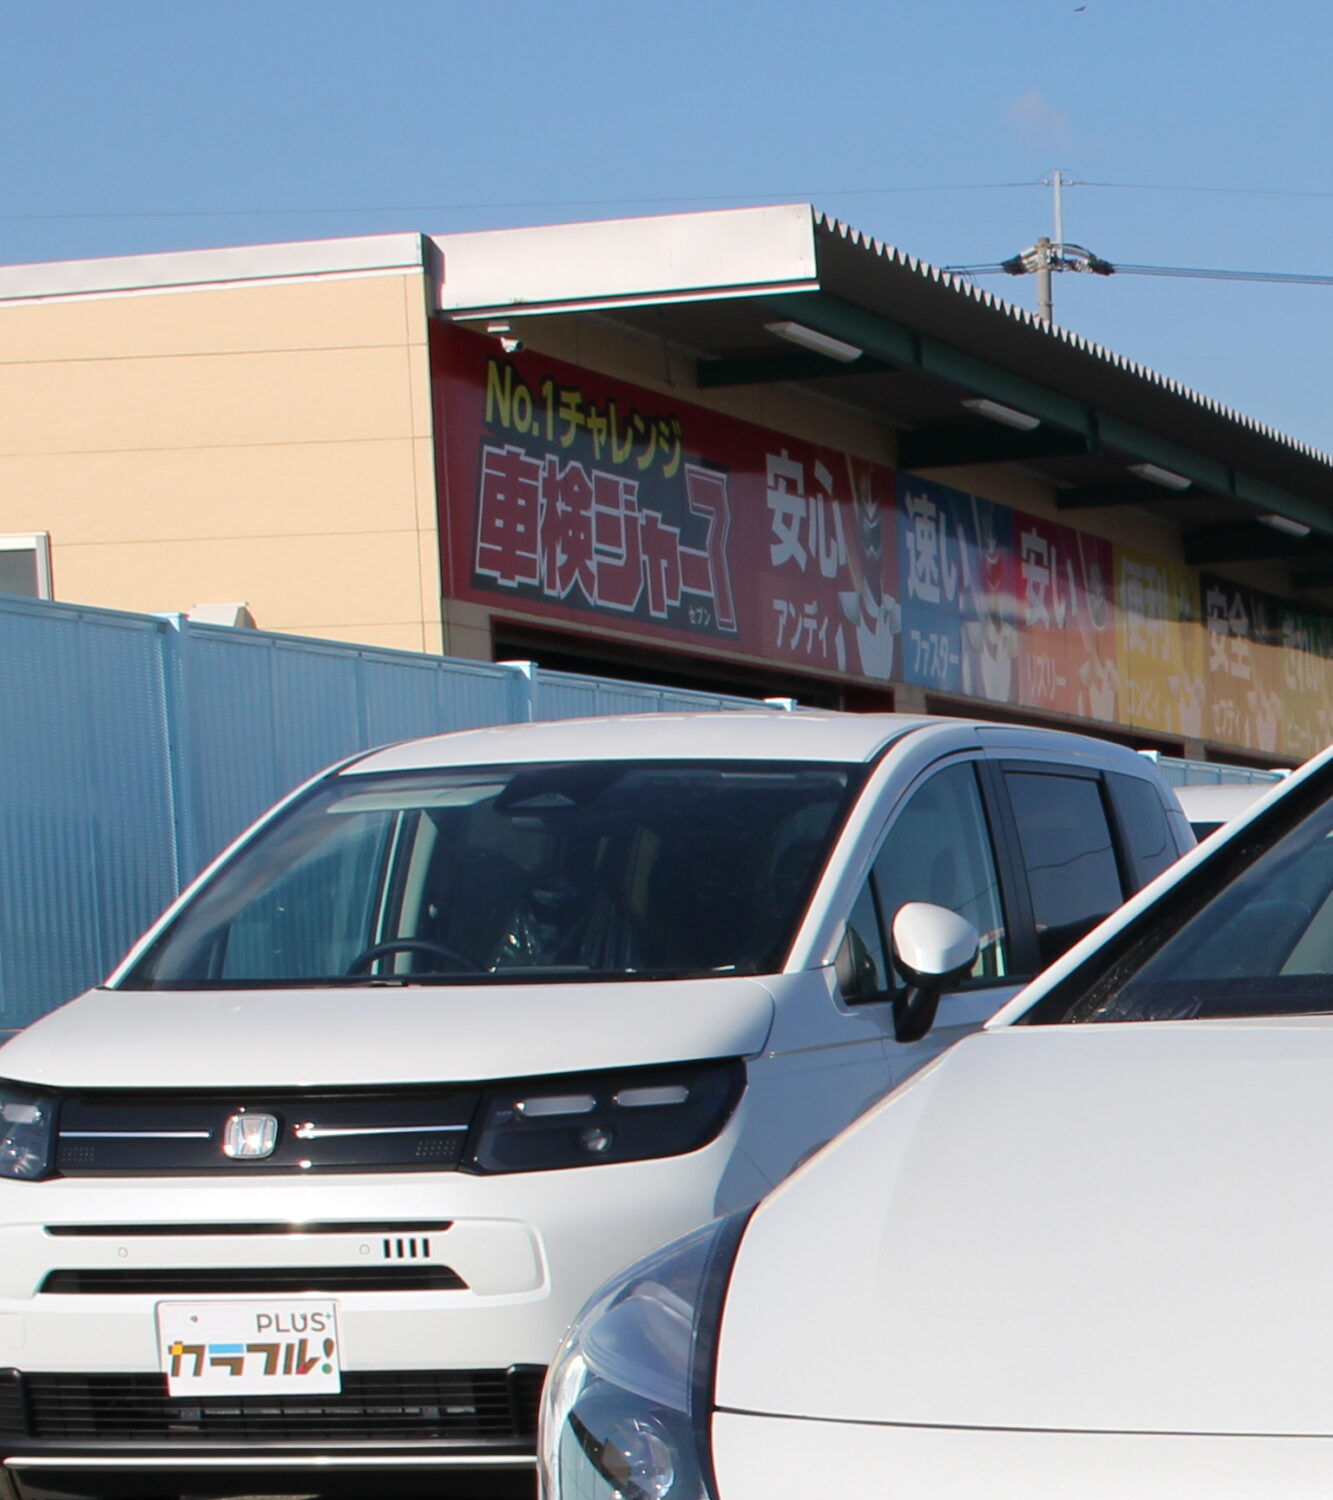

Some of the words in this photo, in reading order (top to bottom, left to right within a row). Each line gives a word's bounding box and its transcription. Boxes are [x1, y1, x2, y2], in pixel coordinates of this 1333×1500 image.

[765, 448, 848, 578] 安心
[905, 491, 972, 604] 速い
[1020, 528, 1079, 630] 安い
